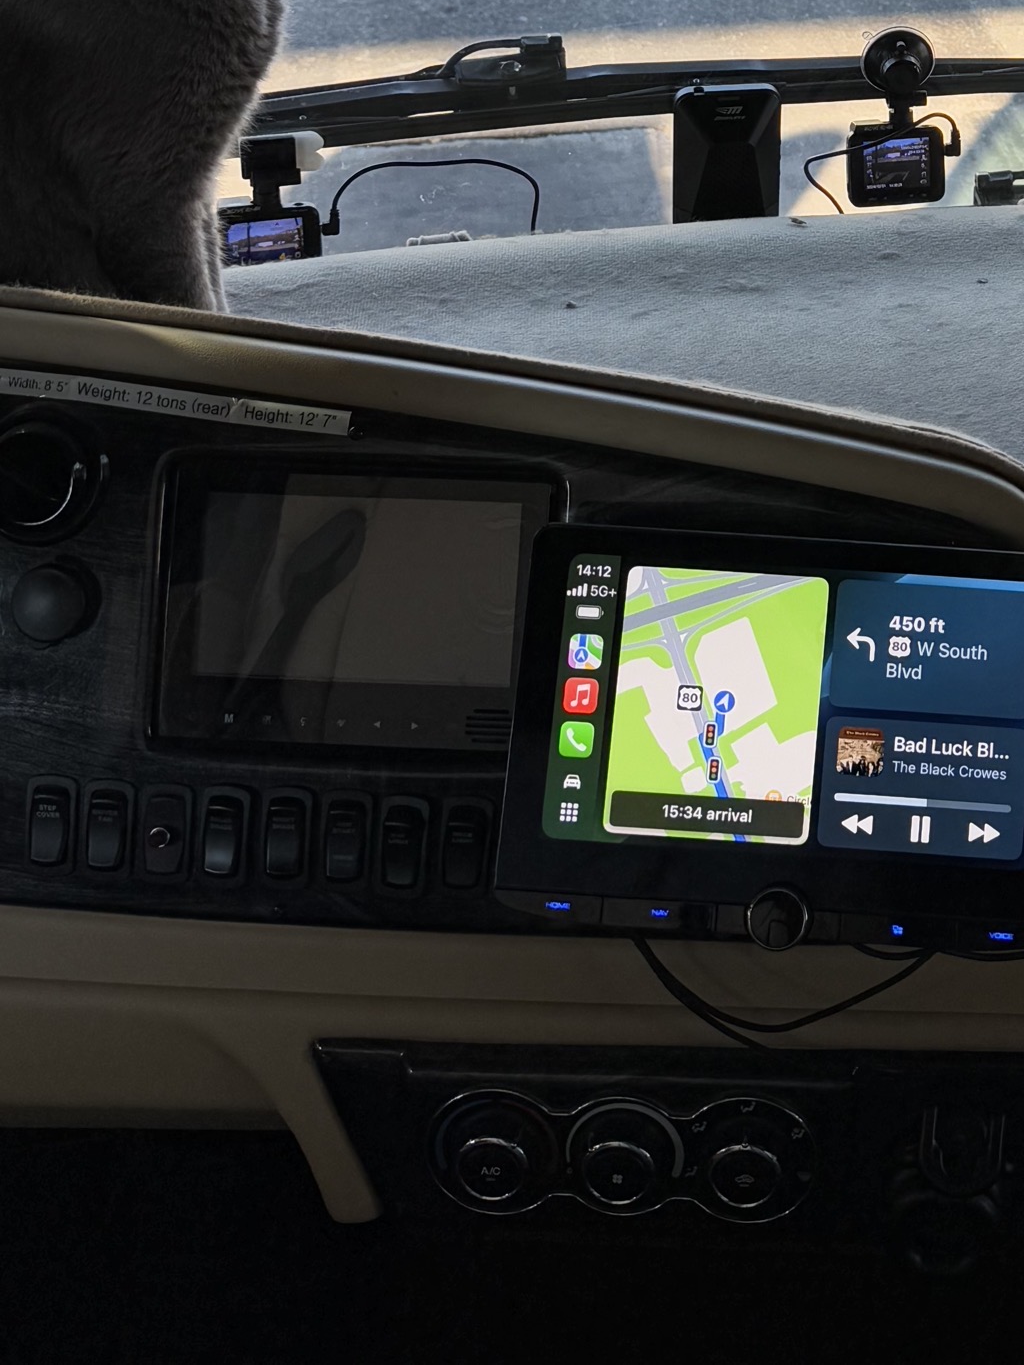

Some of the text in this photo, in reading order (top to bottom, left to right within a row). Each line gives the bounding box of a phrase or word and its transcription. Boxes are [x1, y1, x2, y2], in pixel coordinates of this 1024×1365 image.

[8, 376, 42, 390] Width:
[77, 381, 231, 418] Weight: 12 tons (rear)
[244, 405, 337, 428] Height: 12' 7"
[576, 564, 612, 578] 14:12
[590, 584, 617, 598] 5G+
[889, 615, 945, 634] 450 ft
[891, 640, 988, 661] 80 W South
[886, 662, 922, 680] Blvd
[682, 692, 698, 703] 80
[894, 736, 927, 754] Bad
[931, 738, 973, 757] Luck
[892, 760, 1007, 781] The Black Crowes
[35, 811, 60, 819] COVER
[662, 804, 753, 823] 15:34 arrival
[545, 901, 571, 911] HOME
[651, 908, 670, 917] NAV
[988, 931, 1015, 941] VOICE
[481, 1166, 501, 1176] A/C
